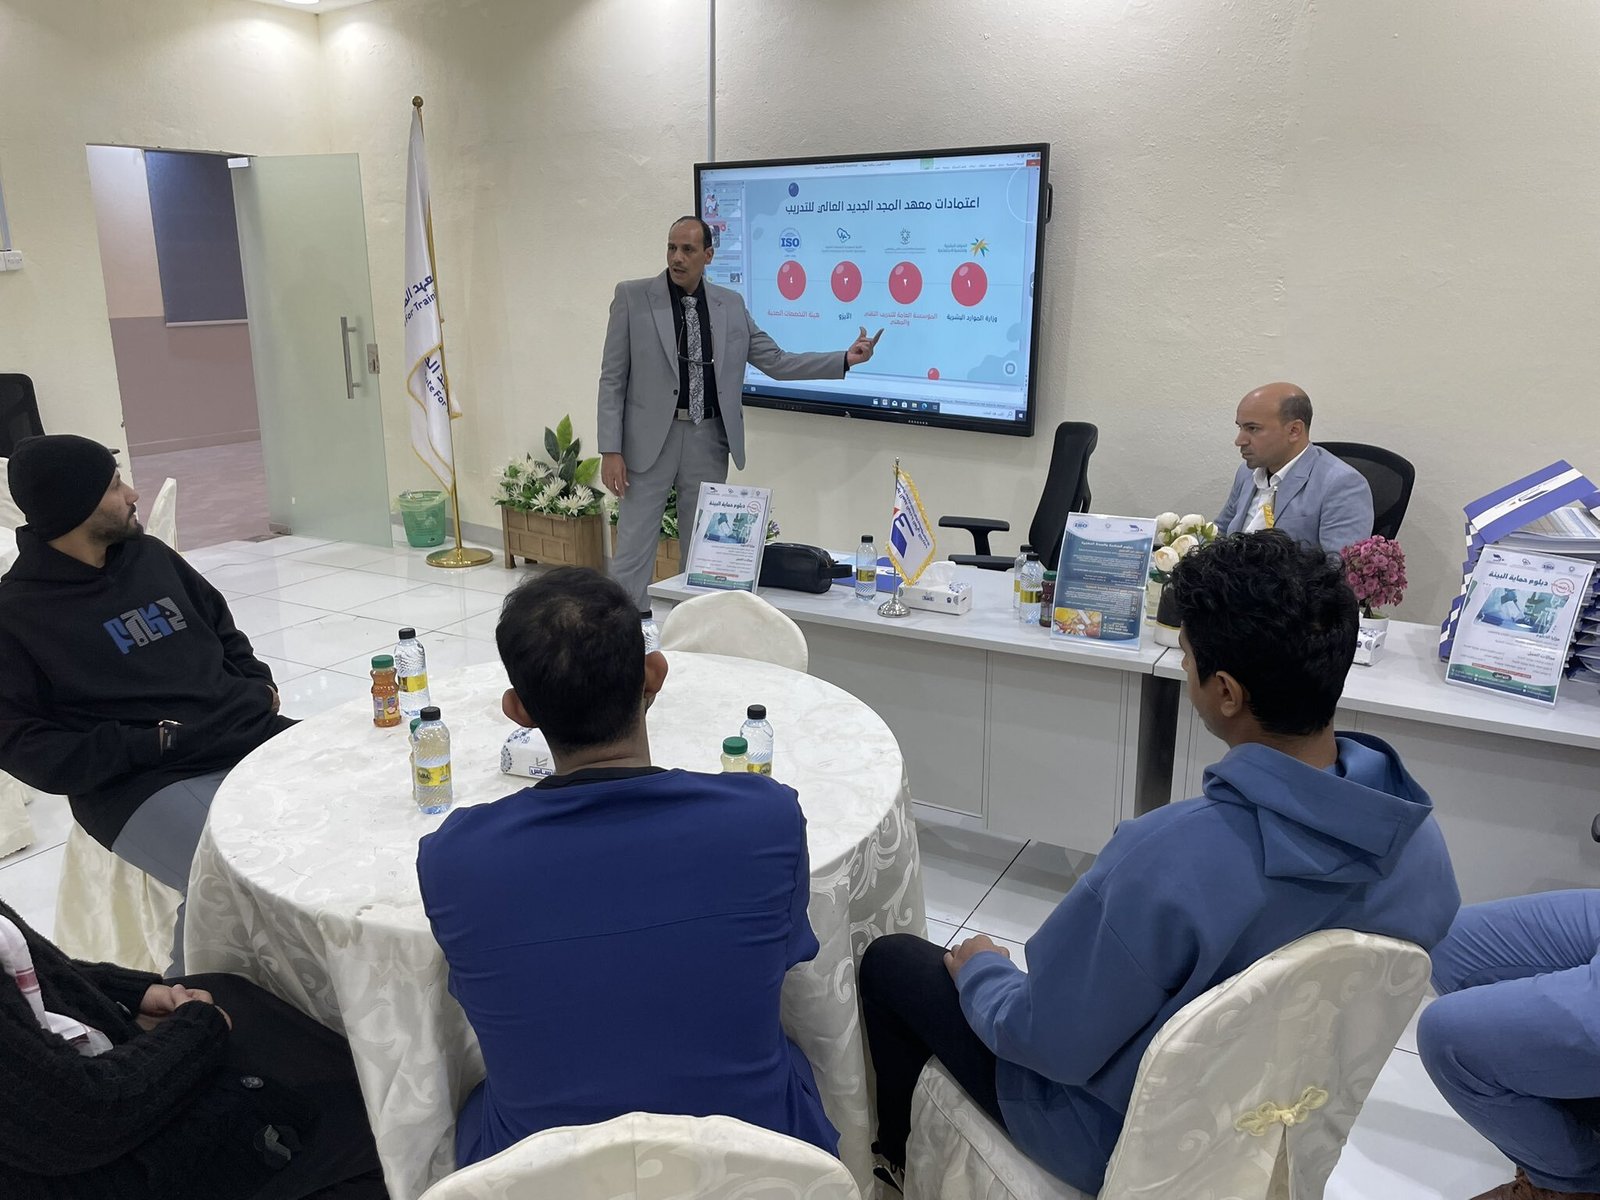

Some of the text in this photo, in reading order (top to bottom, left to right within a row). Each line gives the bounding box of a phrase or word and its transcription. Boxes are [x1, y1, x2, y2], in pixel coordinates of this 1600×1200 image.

[785, 201, 815, 215] للتدريب
[848, 200, 874, 214] الجديد
[876, 199, 901, 212] المجد
[904, 201, 932, 211] معهد
[935, 197, 980, 210] اعتمادات
[780, 237, 800, 248] ISO
[413, 275, 435, 294] عهد
[843, 277, 849, 286] ٣
[903, 278, 908, 287] ٢
[433, 390, 447, 407] For
[1508, 574, 1528, 583] حماية
[1529, 578, 1549, 587] دبلوم
